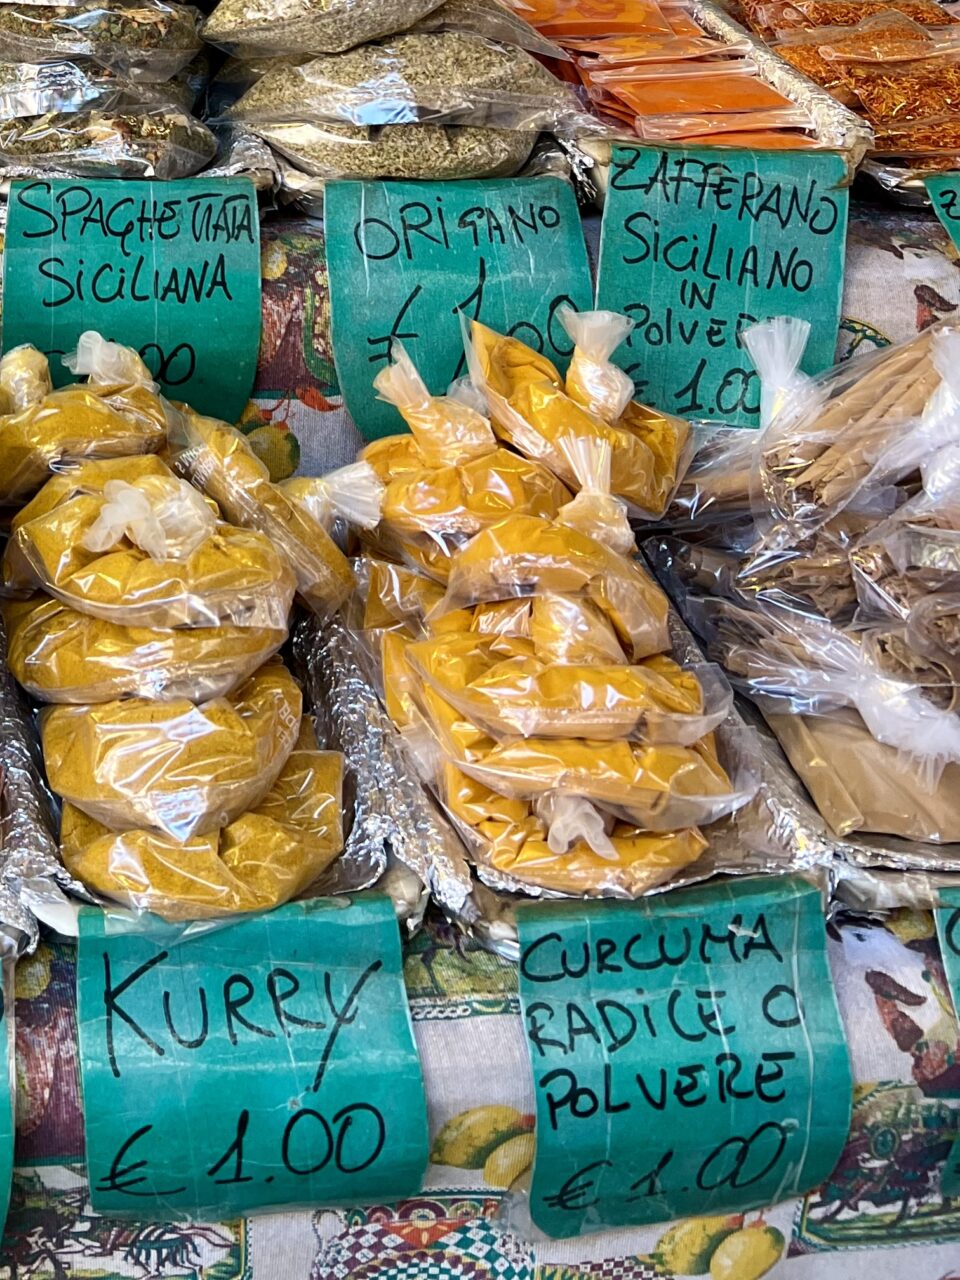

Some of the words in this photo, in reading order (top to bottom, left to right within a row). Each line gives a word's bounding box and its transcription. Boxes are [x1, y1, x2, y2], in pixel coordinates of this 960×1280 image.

[354, 196, 561, 260] ORIGANO
[610, 146, 839, 235] ZAFFERANO
[38, 253, 233, 307] SICILIANA
[622, 211, 814, 293] SICILIANO
[679, 278, 717, 310] IN
[519, 912, 784, 983] CURCUMA
[102, 950, 383, 1093] KURRY
[525, 987, 737, 1057] RADICE
[538, 1050, 797, 1131] POLVERE
[95, 1124, 187, 1197] €
[206, 1102, 386, 1184] 1.00
[542, 1159, 614, 1212] €
[624, 1120, 788, 1204] 1.00
